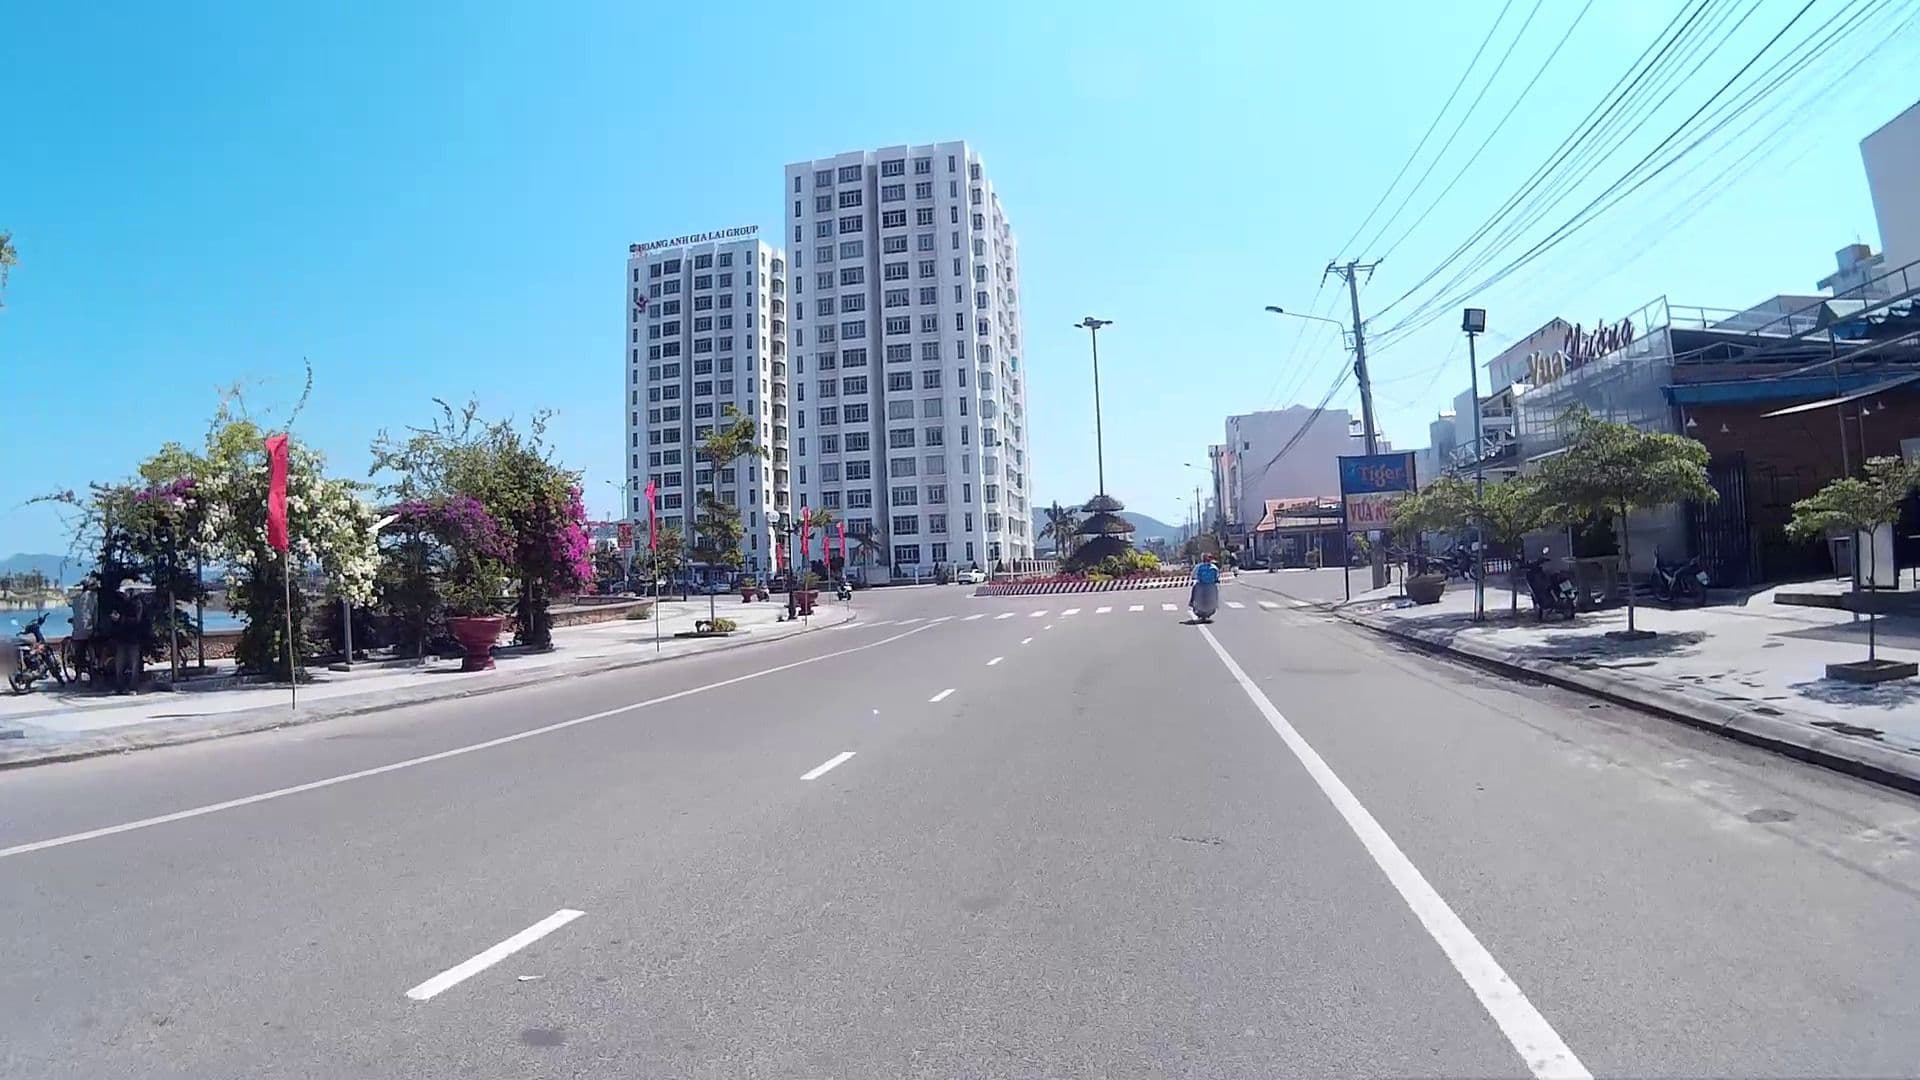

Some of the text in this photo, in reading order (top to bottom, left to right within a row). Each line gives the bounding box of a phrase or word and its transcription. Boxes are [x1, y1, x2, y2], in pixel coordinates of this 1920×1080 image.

[669, 235, 689, 247] ANH
[690, 232, 707, 243] GIA
[709, 230, 725, 240] LAI
[726, 225, 759, 237] GROUP
[1359, 464, 1402, 487] Tiger
